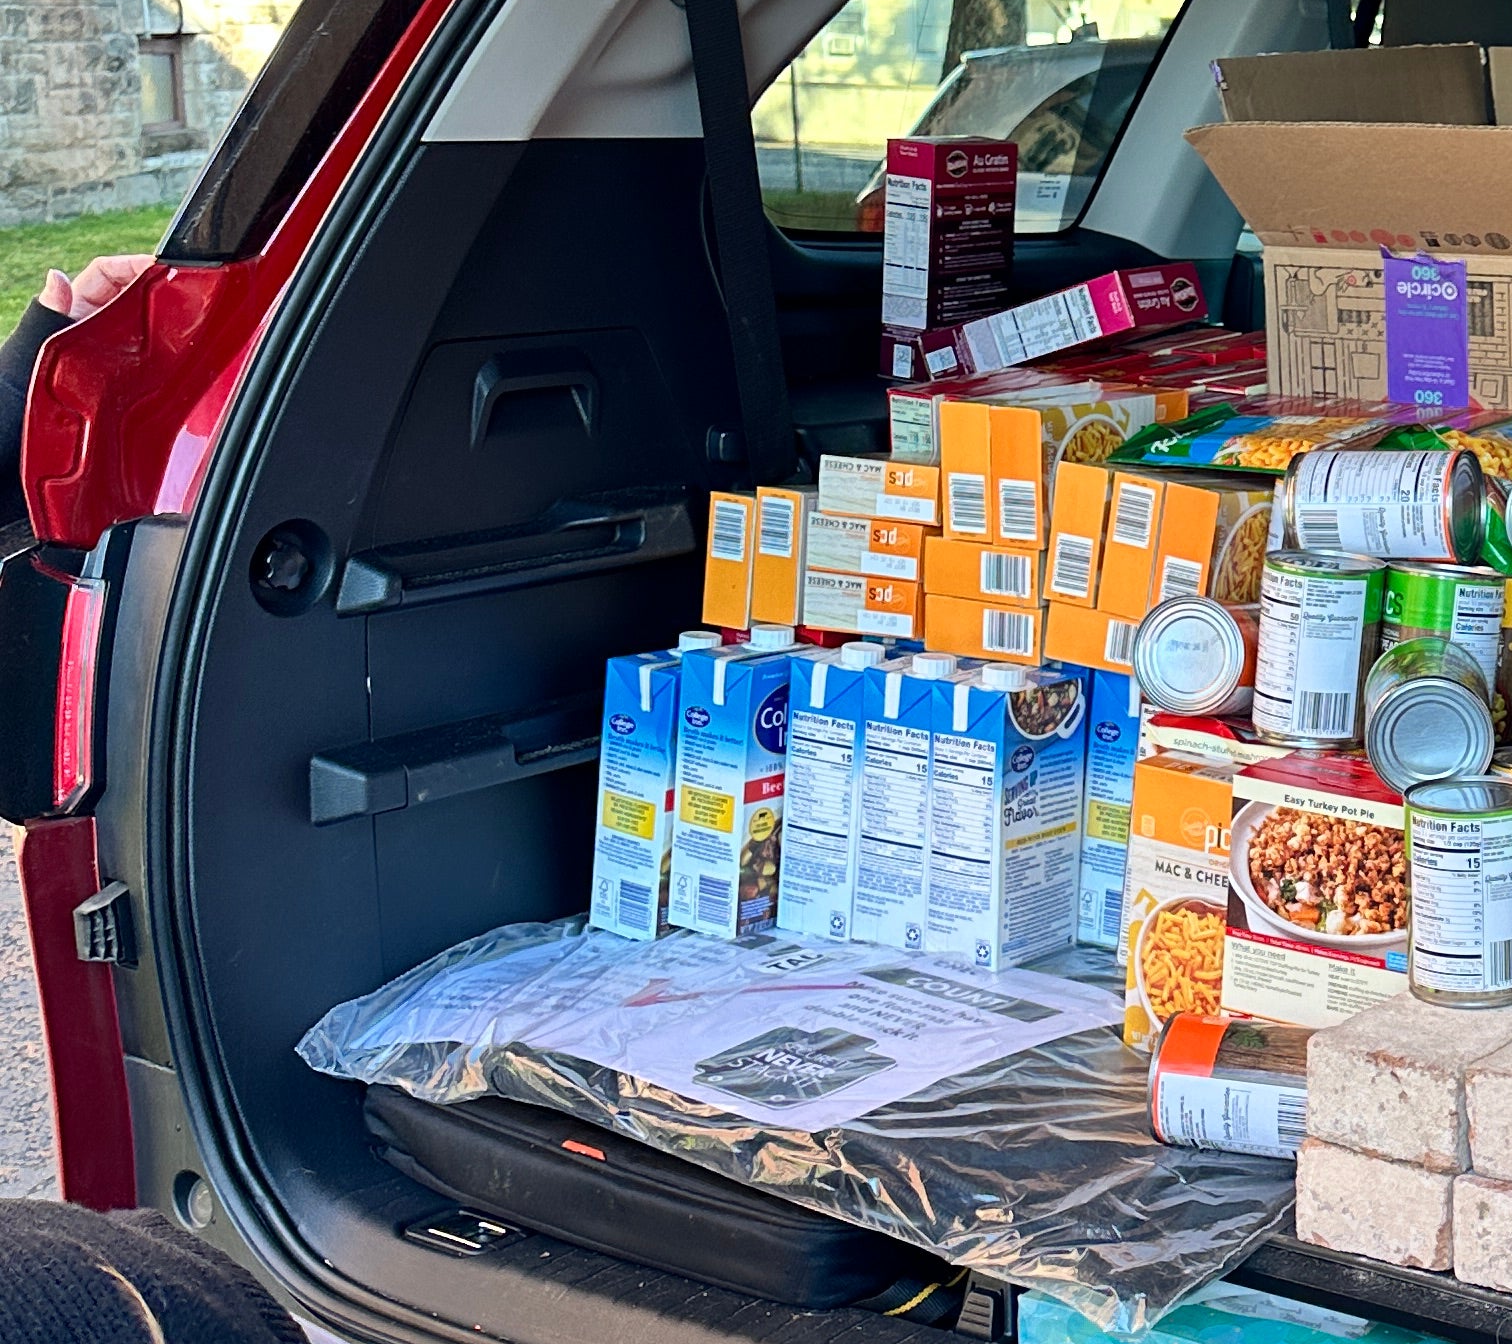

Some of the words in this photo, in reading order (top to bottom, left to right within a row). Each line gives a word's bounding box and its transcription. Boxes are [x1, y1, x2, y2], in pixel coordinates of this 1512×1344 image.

[912, 181, 927, 192] Facts
[1412, 266, 1440, 281] 360
[1397, 282, 1441, 300] circle
[1414, 390, 1442, 405] 360
[824, 459, 855, 472] CHEESE
[862, 464, 883, 474] MAC
[889, 471, 914, 489] pics
[1400, 490, 1410, 503] 20
[1430, 477, 1442, 503] Facts
[811, 517, 841, 528] CHEESE
[847, 522, 867, 531] MAC
[873, 527, 898, 546] pics
[807, 576, 836, 587] CHEESE
[843, 581, 862, 590] MAC
[1280, 576, 1303, 589] Facts
[869, 585, 893, 605] pics
[1459, 587, 1493, 599] Nutrition
[1290, 612, 1300, 622] 50
[1455, 622, 1484, 632] Calories
[610, 716, 635, 729] College
[685, 709, 710, 721] College
[793, 711, 829, 726] Nutrition
[831, 718, 854, 731] Facts
[684, 727, 702, 736] Broth
[702, 730, 719, 740] makes
[725, 734, 744, 746] better!
[866, 721, 903, 737] Nutrition
[905, 728, 929, 741] Facts
[1096, 726, 1120, 737] College
[608, 733, 625, 744] Broth
[626, 736, 646, 748] makes
[934, 734, 971, 749] Nutrition
[973, 742, 995, 753] Facts
[791, 746, 817, 757] Calories
[841, 754, 852, 763] 15
[865, 756, 892, 767] Calories
[916, 763, 927, 774] 15
[933, 769, 959, 781] Calories
[982, 776, 993, 786] 15
[762, 782, 784, 795] Bee
[1284, 794, 1305, 808] Easy
[1307, 799, 1339, 814] Turkey
[1342, 806, 1357, 817] Pot
[1360, 809, 1375, 819] Pie
[1004, 805, 1039, 827] Flavor
[1412, 815, 1447, 832] Nutrition
[1450, 822, 1481, 834] Facts
[1205, 823, 1231, 854] pic
[1466, 857, 1481, 869] 15
[1155, 859, 1181, 877] MAC
[1184, 866, 1192, 880] &
[1196, 870, 1229, 888] CHEE
[1231, 941, 1251, 953] What
[1252, 944, 1266, 957] you
[1267, 948, 1287, 961] need
[1328, 964, 1349, 975] Make
[889, 993, 922, 1006] sure
[906, 976, 1010, 1006] COUNT
[848, 992, 880, 1004] one
[880, 1000, 918, 1015] floor
[803, 1005, 858, 1022] double
[859, 1020, 904, 1037] stack
[839, 1002, 874, 1015] and
[870, 1010, 927, 1030] NEVER
[755, 1048, 836, 1079] NEVER
